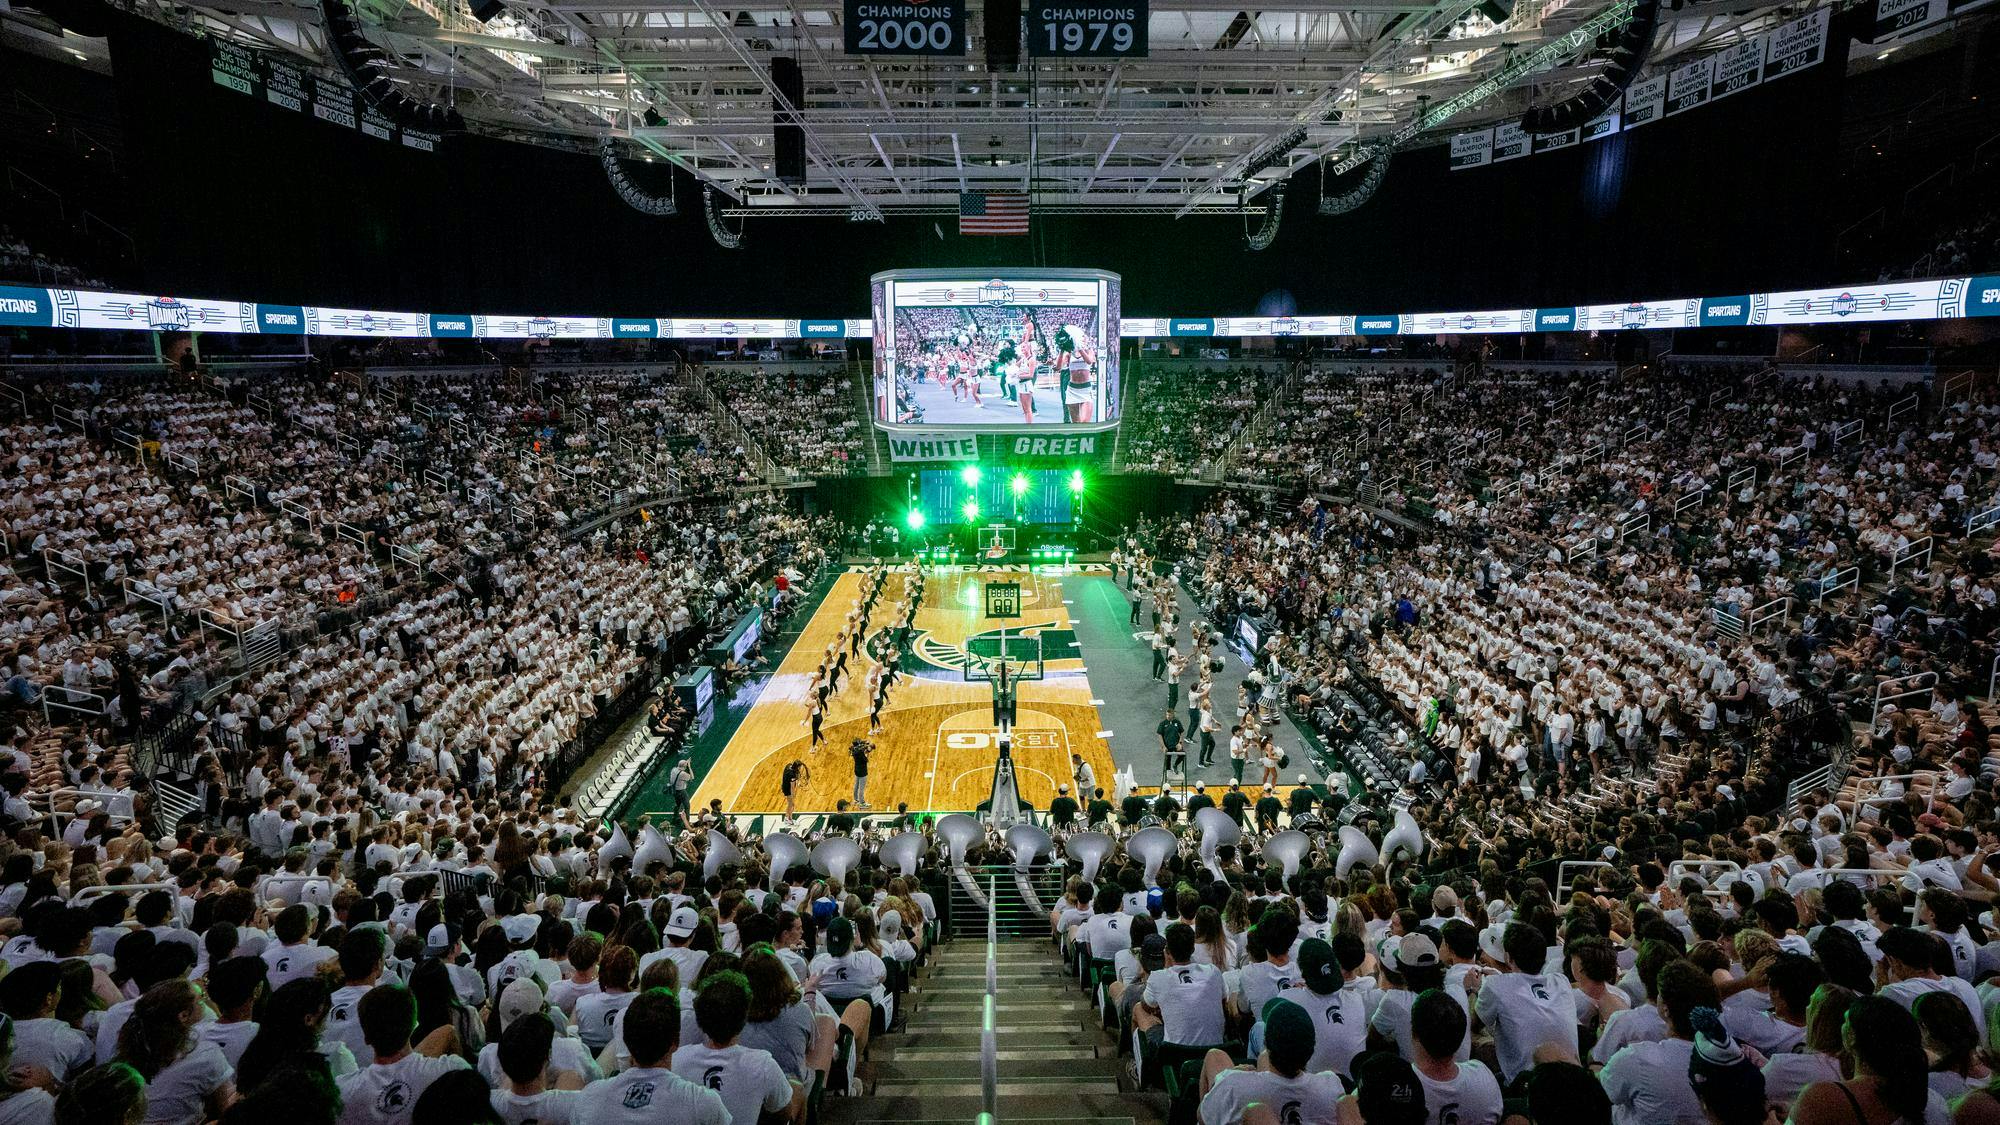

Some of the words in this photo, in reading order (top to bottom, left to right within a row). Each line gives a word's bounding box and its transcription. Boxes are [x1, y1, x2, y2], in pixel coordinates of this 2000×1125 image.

[857, 5, 952, 19] CHAMPIONS
[1041, 8, 1135, 21] CHAMPIONS
[1895, 6, 1926, 28] 2012
[858, 20, 952, 50] 2000
[1044, 22, 1134, 52] 1979
[1775, 24, 1822, 48] TOURNAMENT
[214, 37, 252, 61] WOMEN'S
[1774, 33, 1821, 58] CHAMPIONS
[220, 50, 235, 64] BIG
[234, 56, 251, 70] TEN
[1721, 48, 1761, 70] TOURNAMENT
[1780, 51, 1808, 72] 2012
[212, 58, 261, 83] CHAMPIONS
[268, 59, 302, 80] WOMEN'S
[1720, 57, 1760, 80] CHAMPIONS
[228, 76, 249, 92] 1997
[273, 71, 286, 84] BIG
[287, 76, 300, 89] TEN
[1673, 77, 1709, 98] CHAMPIONS
[1725, 72, 1749, 92] 2014
[266, 78, 309, 101] CHAMPIONS
[1633, 87, 1644, 98] BIG
[1645, 82, 1658, 93] TEN
[280, 94, 300, 111] 2005
[317, 95, 355, 115] CHAMPIONS
[1626, 90, 1664, 110] CHAMPIONS
[1679, 91, 1699, 110] 2016
[325, 108, 348, 125] 2005
[361, 112, 397, 131] CHAMPIONS
[402, 127, 442, 143] CHAMPIONS
[1593, 121, 1610, 134] 2019
[414, 139, 433, 151] 2014
[1451, 141, 1492, 155] CHAMPIONS
[1459, 137, 1471, 146] BIG
[1471, 134, 1485, 144] TEN
[1546, 134, 1567, 148] 2019
[1503, 145, 1521, 156] 2020
[979, 286, 1015, 303] MADNESS
[148, 303, 189, 327] MADNESS
[265, 313, 298, 326] SPARTANS
[1541, 314, 1570, 325] SPARTANS
[1707, 304, 1741, 317] SPARTANS
[436, 321, 466, 331] SPARTANS
[619, 324, 651, 333] SPARTANS
[807, 324, 838, 333] SPARTANS
[1176, 323, 1207, 332] SPARTANS
[1361, 320, 1392, 330] SPARTANS
[890, 439, 975, 457] WHITE
[1014, 437, 1095, 456] GREEN
